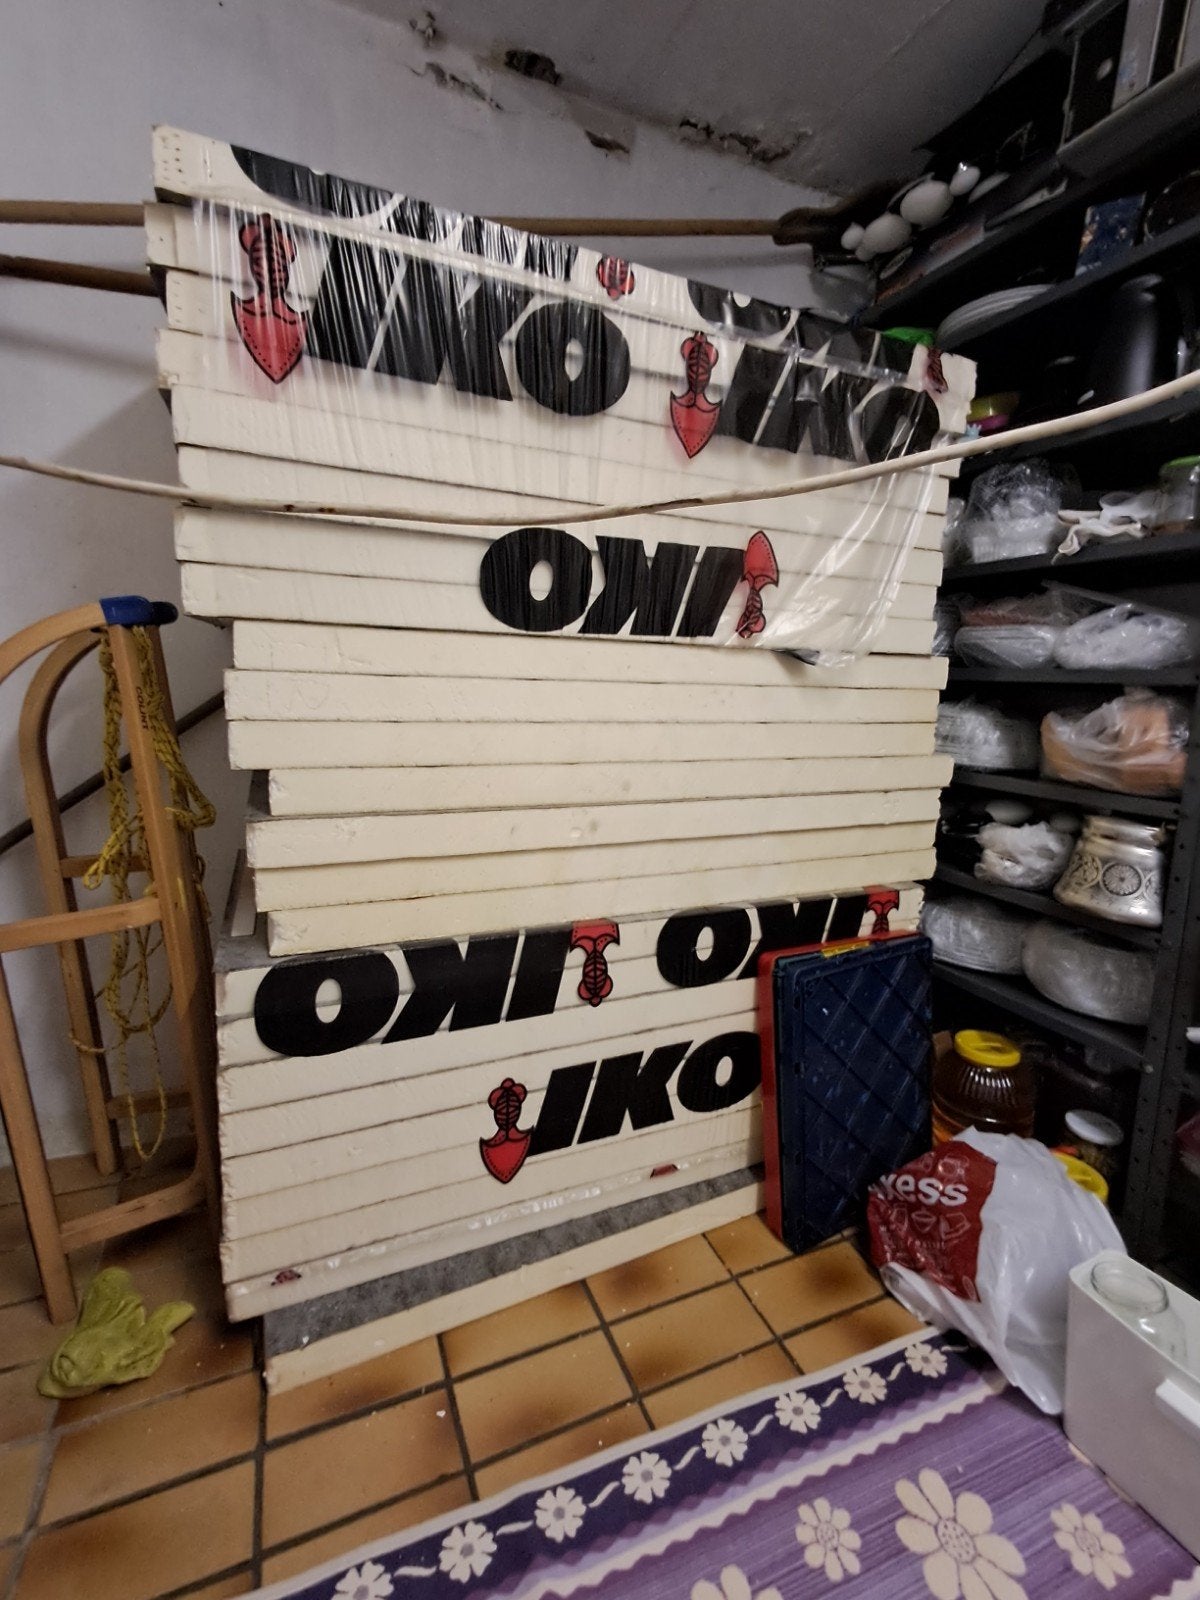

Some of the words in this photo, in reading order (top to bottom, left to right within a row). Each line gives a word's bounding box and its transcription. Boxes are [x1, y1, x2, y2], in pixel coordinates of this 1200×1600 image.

[304, 236, 631, 417] IKO
[480, 527, 746, 637] IKO
[255, 921, 574, 1057] IKO
[526, 1031, 762, 1156] IKO
